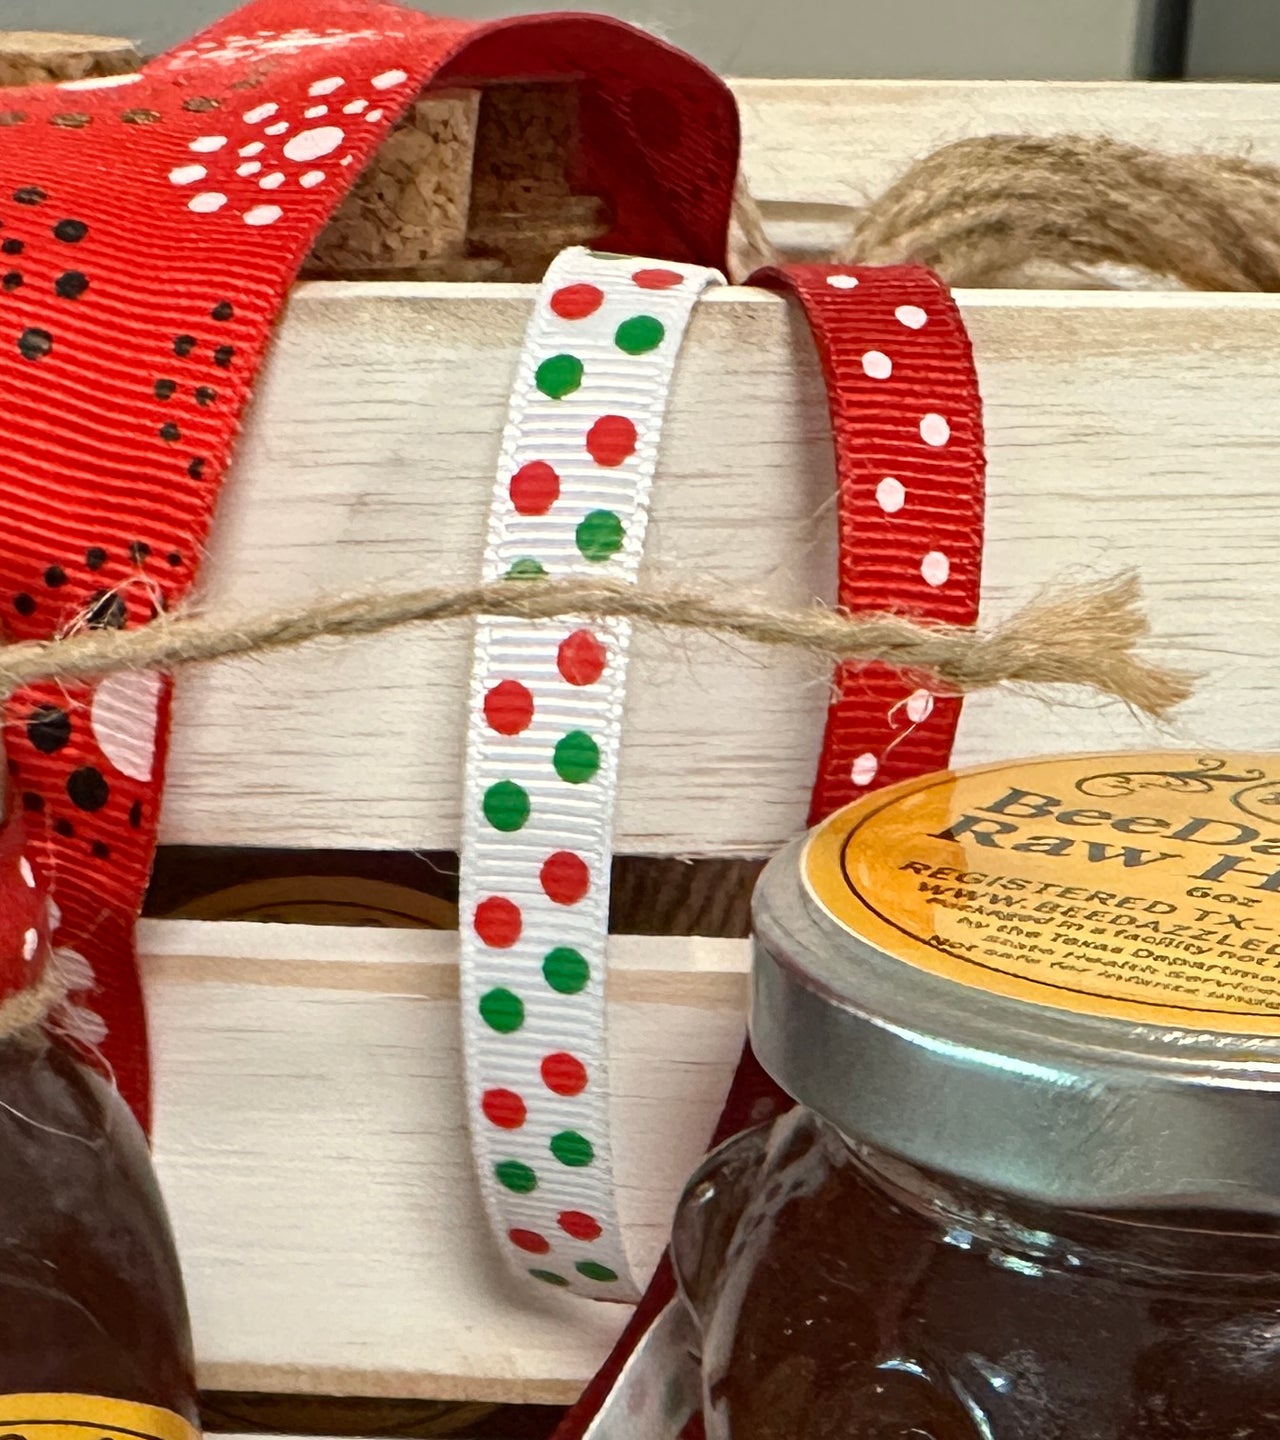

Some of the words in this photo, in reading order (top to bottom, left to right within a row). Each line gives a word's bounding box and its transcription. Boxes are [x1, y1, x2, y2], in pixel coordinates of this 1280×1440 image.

[926, 813, 1184, 868] Raw
[898, 861, 1179, 915] REGISTERED
[1185, 886, 1263, 909] 6oz
